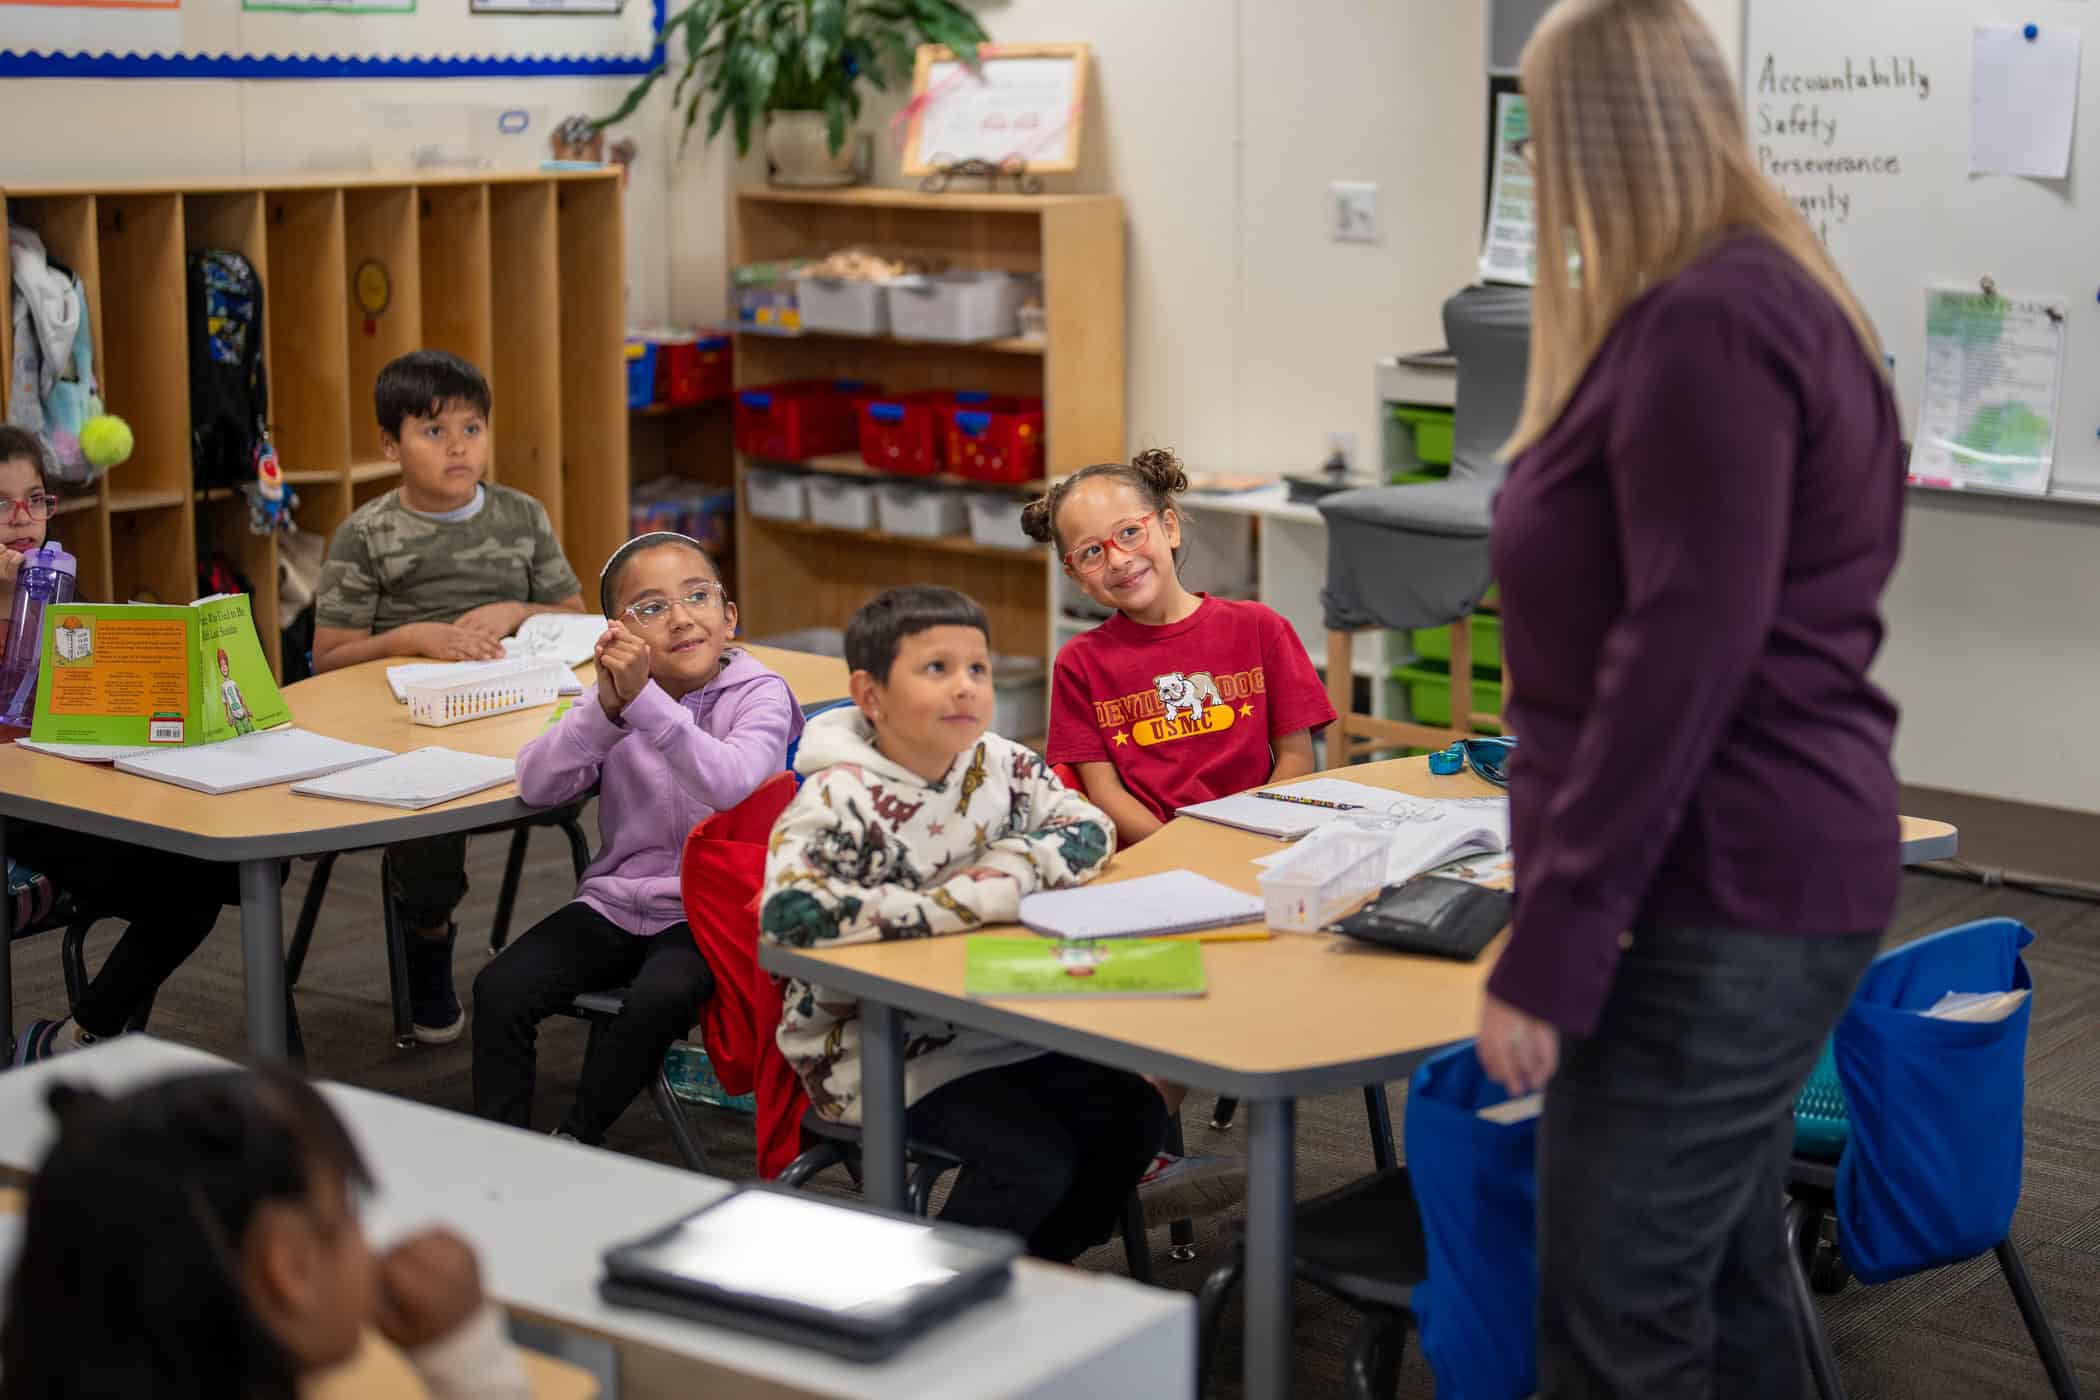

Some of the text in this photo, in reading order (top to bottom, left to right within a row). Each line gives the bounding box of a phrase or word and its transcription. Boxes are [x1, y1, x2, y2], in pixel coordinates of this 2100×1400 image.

[1757, 53, 1931, 99] Accountability
[1758, 103, 1837, 145] Safety
[1757, 145, 1901, 175] Perseverance
[1150, 712, 1213, 740] USMC
